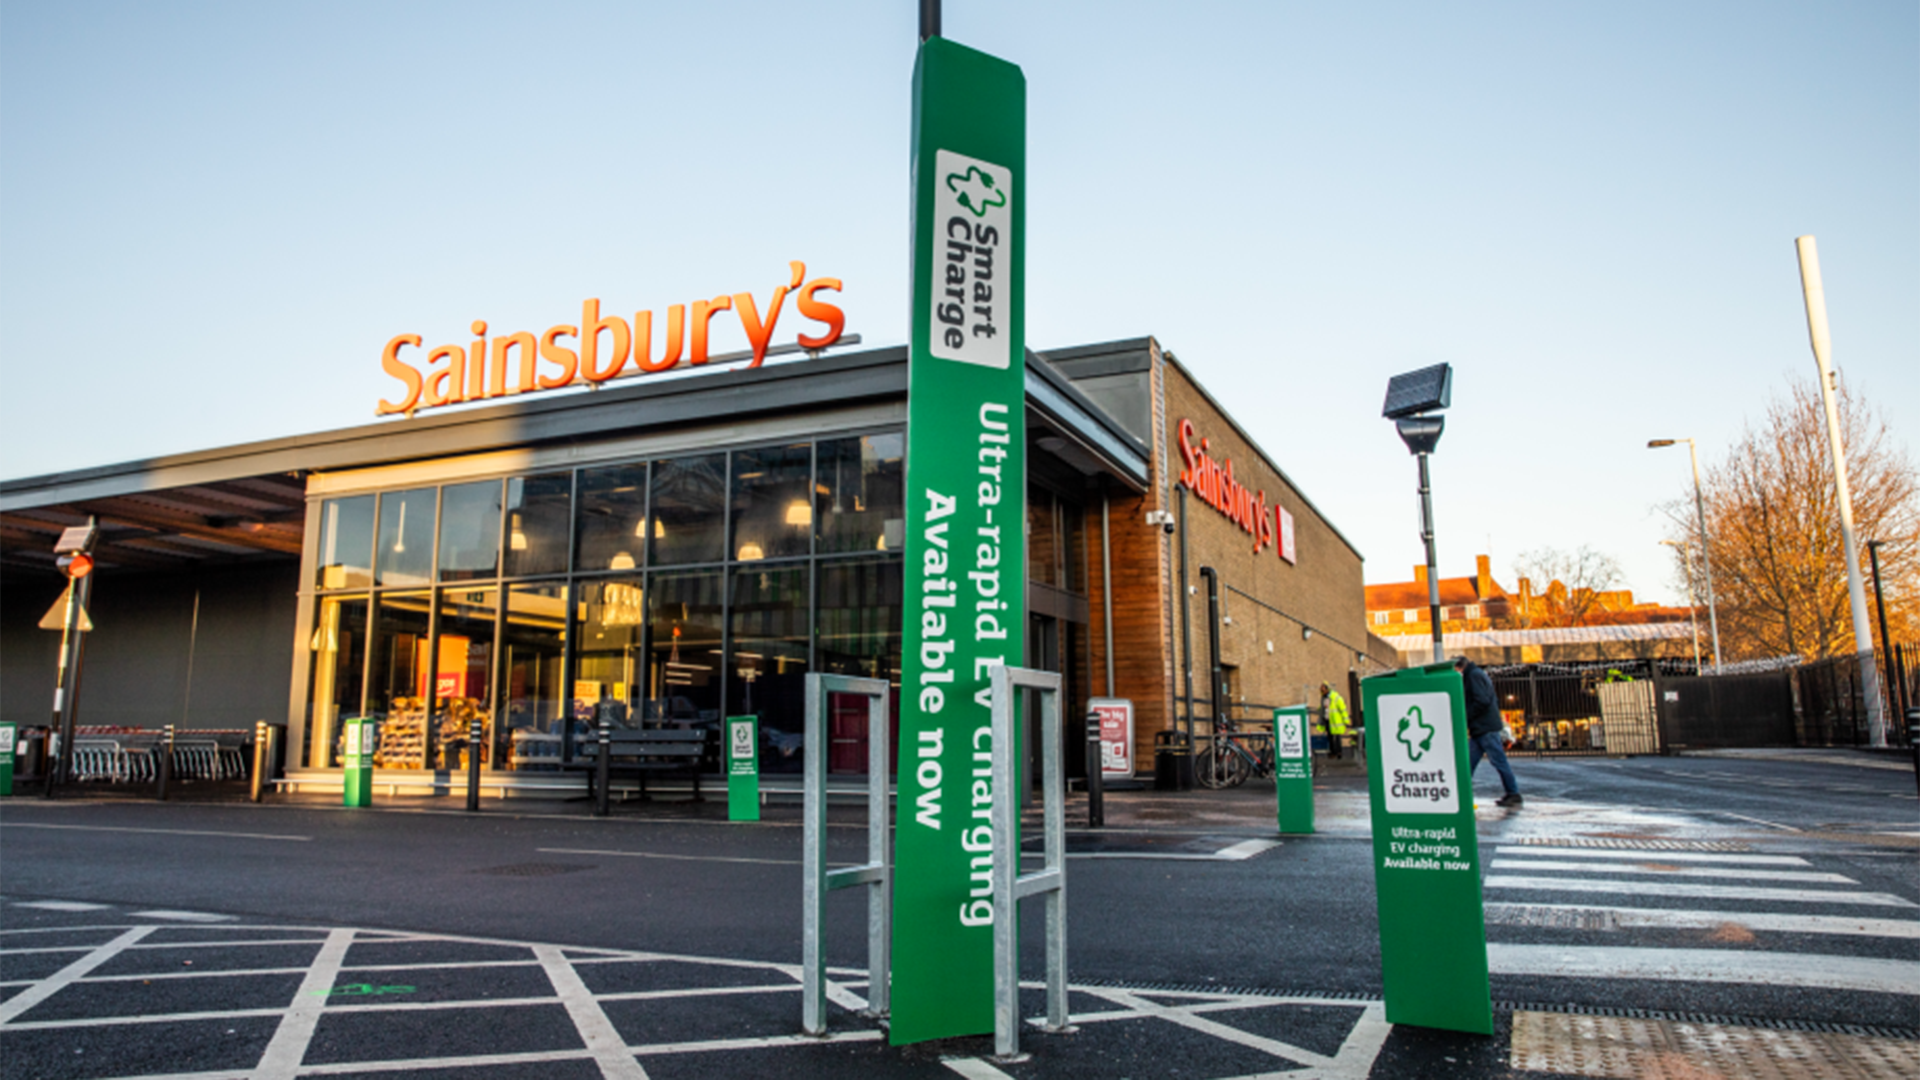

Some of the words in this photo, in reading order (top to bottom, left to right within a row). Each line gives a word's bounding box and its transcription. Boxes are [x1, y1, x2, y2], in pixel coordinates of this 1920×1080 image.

[937, 216, 972, 350] Charge
[972, 223, 998, 339] Smart
[374, 260, 846, 418] Sainsbury's
[968, 402, 1010, 641] Ultra-rapid
[1178, 418, 1272, 554] Sainsbury's
[919, 488, 956, 713] Available
[916, 727, 944, 830] now
[1391, 784, 1450, 801] Charge
[1393, 769, 1445, 783] Smart
[1384, 856, 1440, 870] Available
[1443, 861, 1470, 870] now
[1390, 842, 1405, 853] EV
[1408, 842, 1460, 857] charging
[1391, 826, 1456, 841] Ultra-rapid
